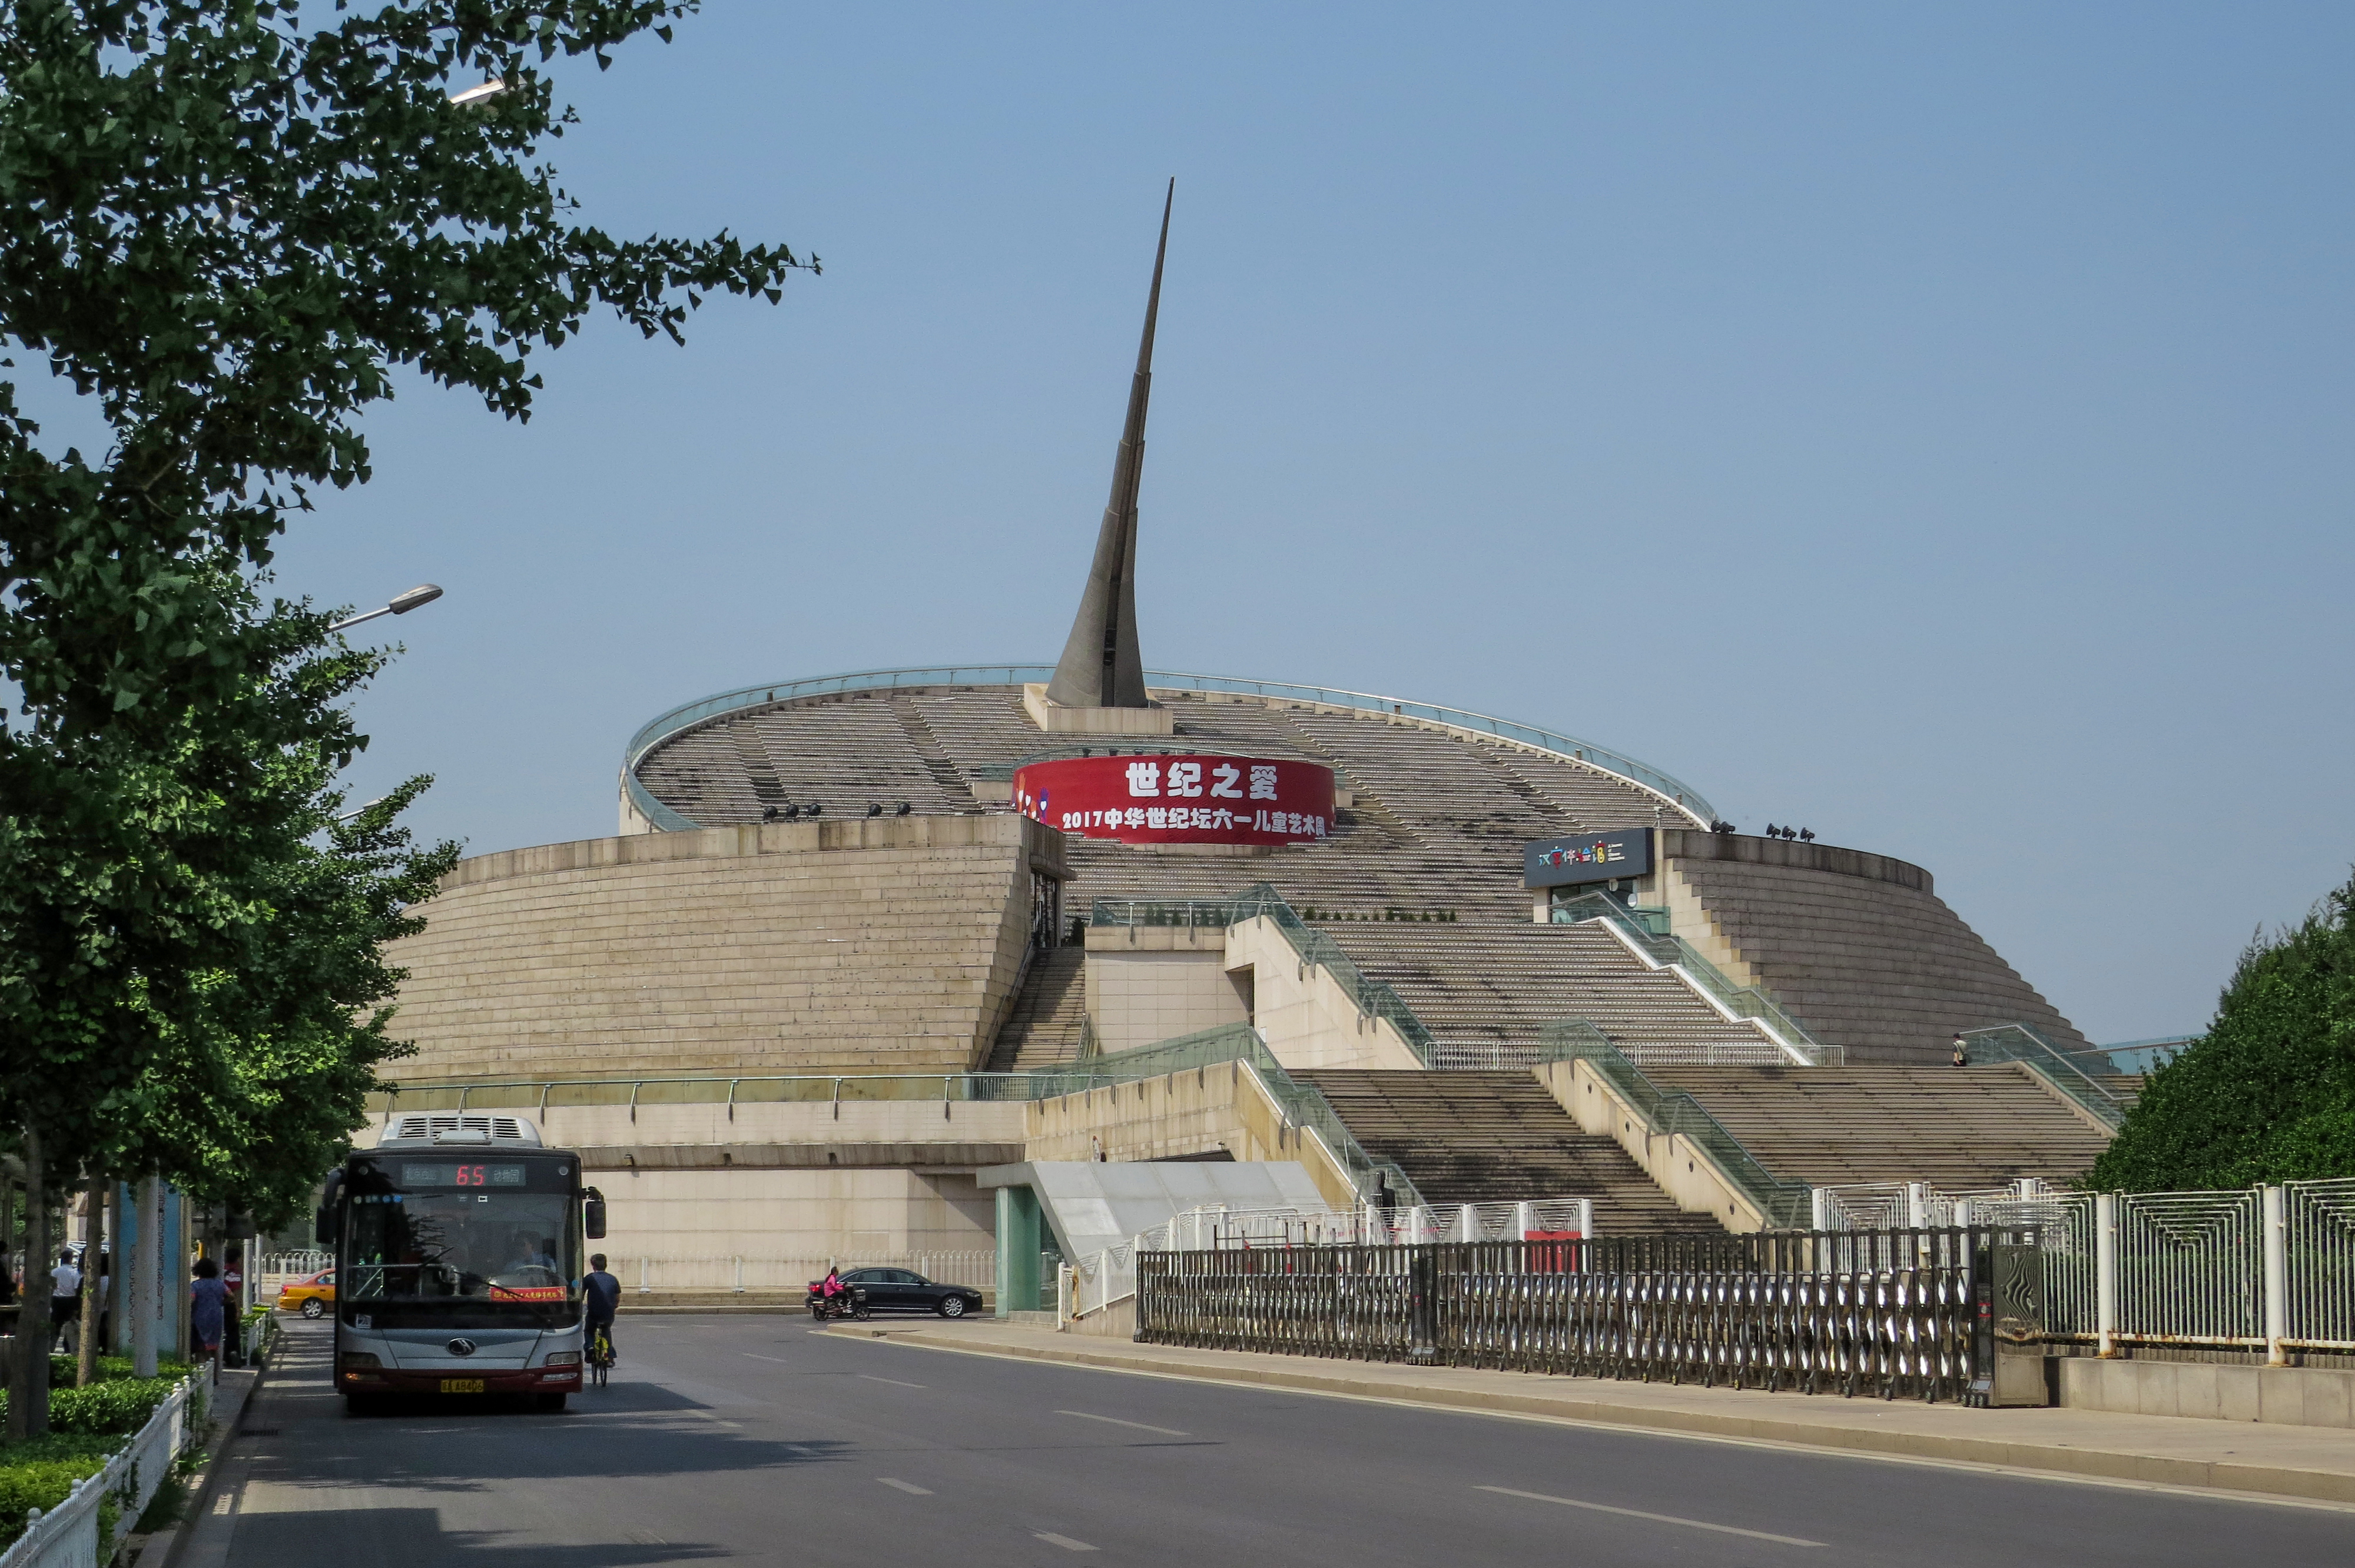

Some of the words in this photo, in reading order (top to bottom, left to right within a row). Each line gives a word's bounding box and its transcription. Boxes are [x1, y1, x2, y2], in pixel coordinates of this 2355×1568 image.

[1125, 762, 1278, 801] 世纪之爱
[456, 1165, 485, 1185] 65
